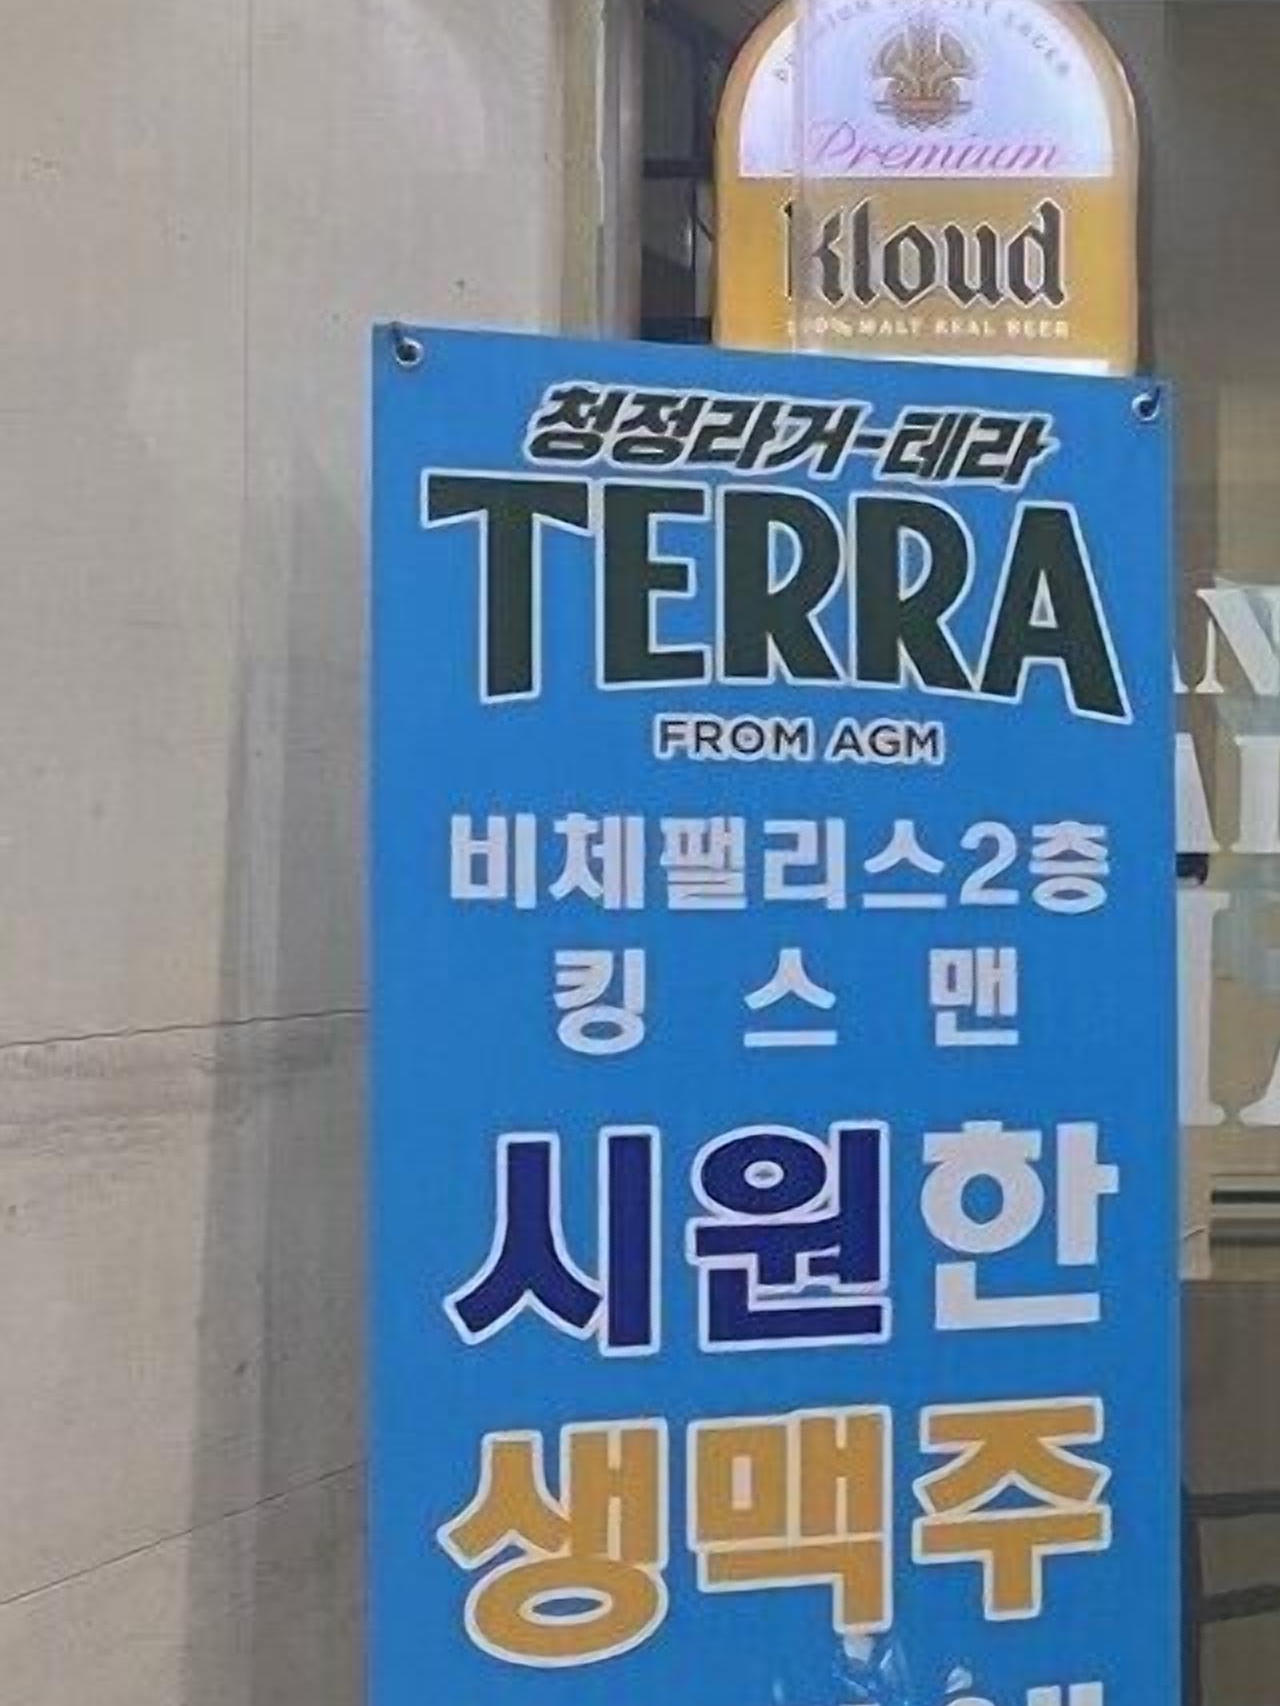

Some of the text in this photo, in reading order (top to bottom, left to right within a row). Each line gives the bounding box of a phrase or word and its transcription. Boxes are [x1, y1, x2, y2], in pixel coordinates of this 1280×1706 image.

[808, 119, 1058, 171] Premium
[779, 196, 1066, 309] Kloud
[525, 382, 1060, 488] 청정라거-테라
[421, 469, 1133, 725] TERRA
[655, 713, 943, 764] FROM AGM
[449, 812, 1109, 914] 비체팰리스2층
[443, 1119, 1121, 1357] 시원한
[437, 1396, 1112, 1668] 생맥주
